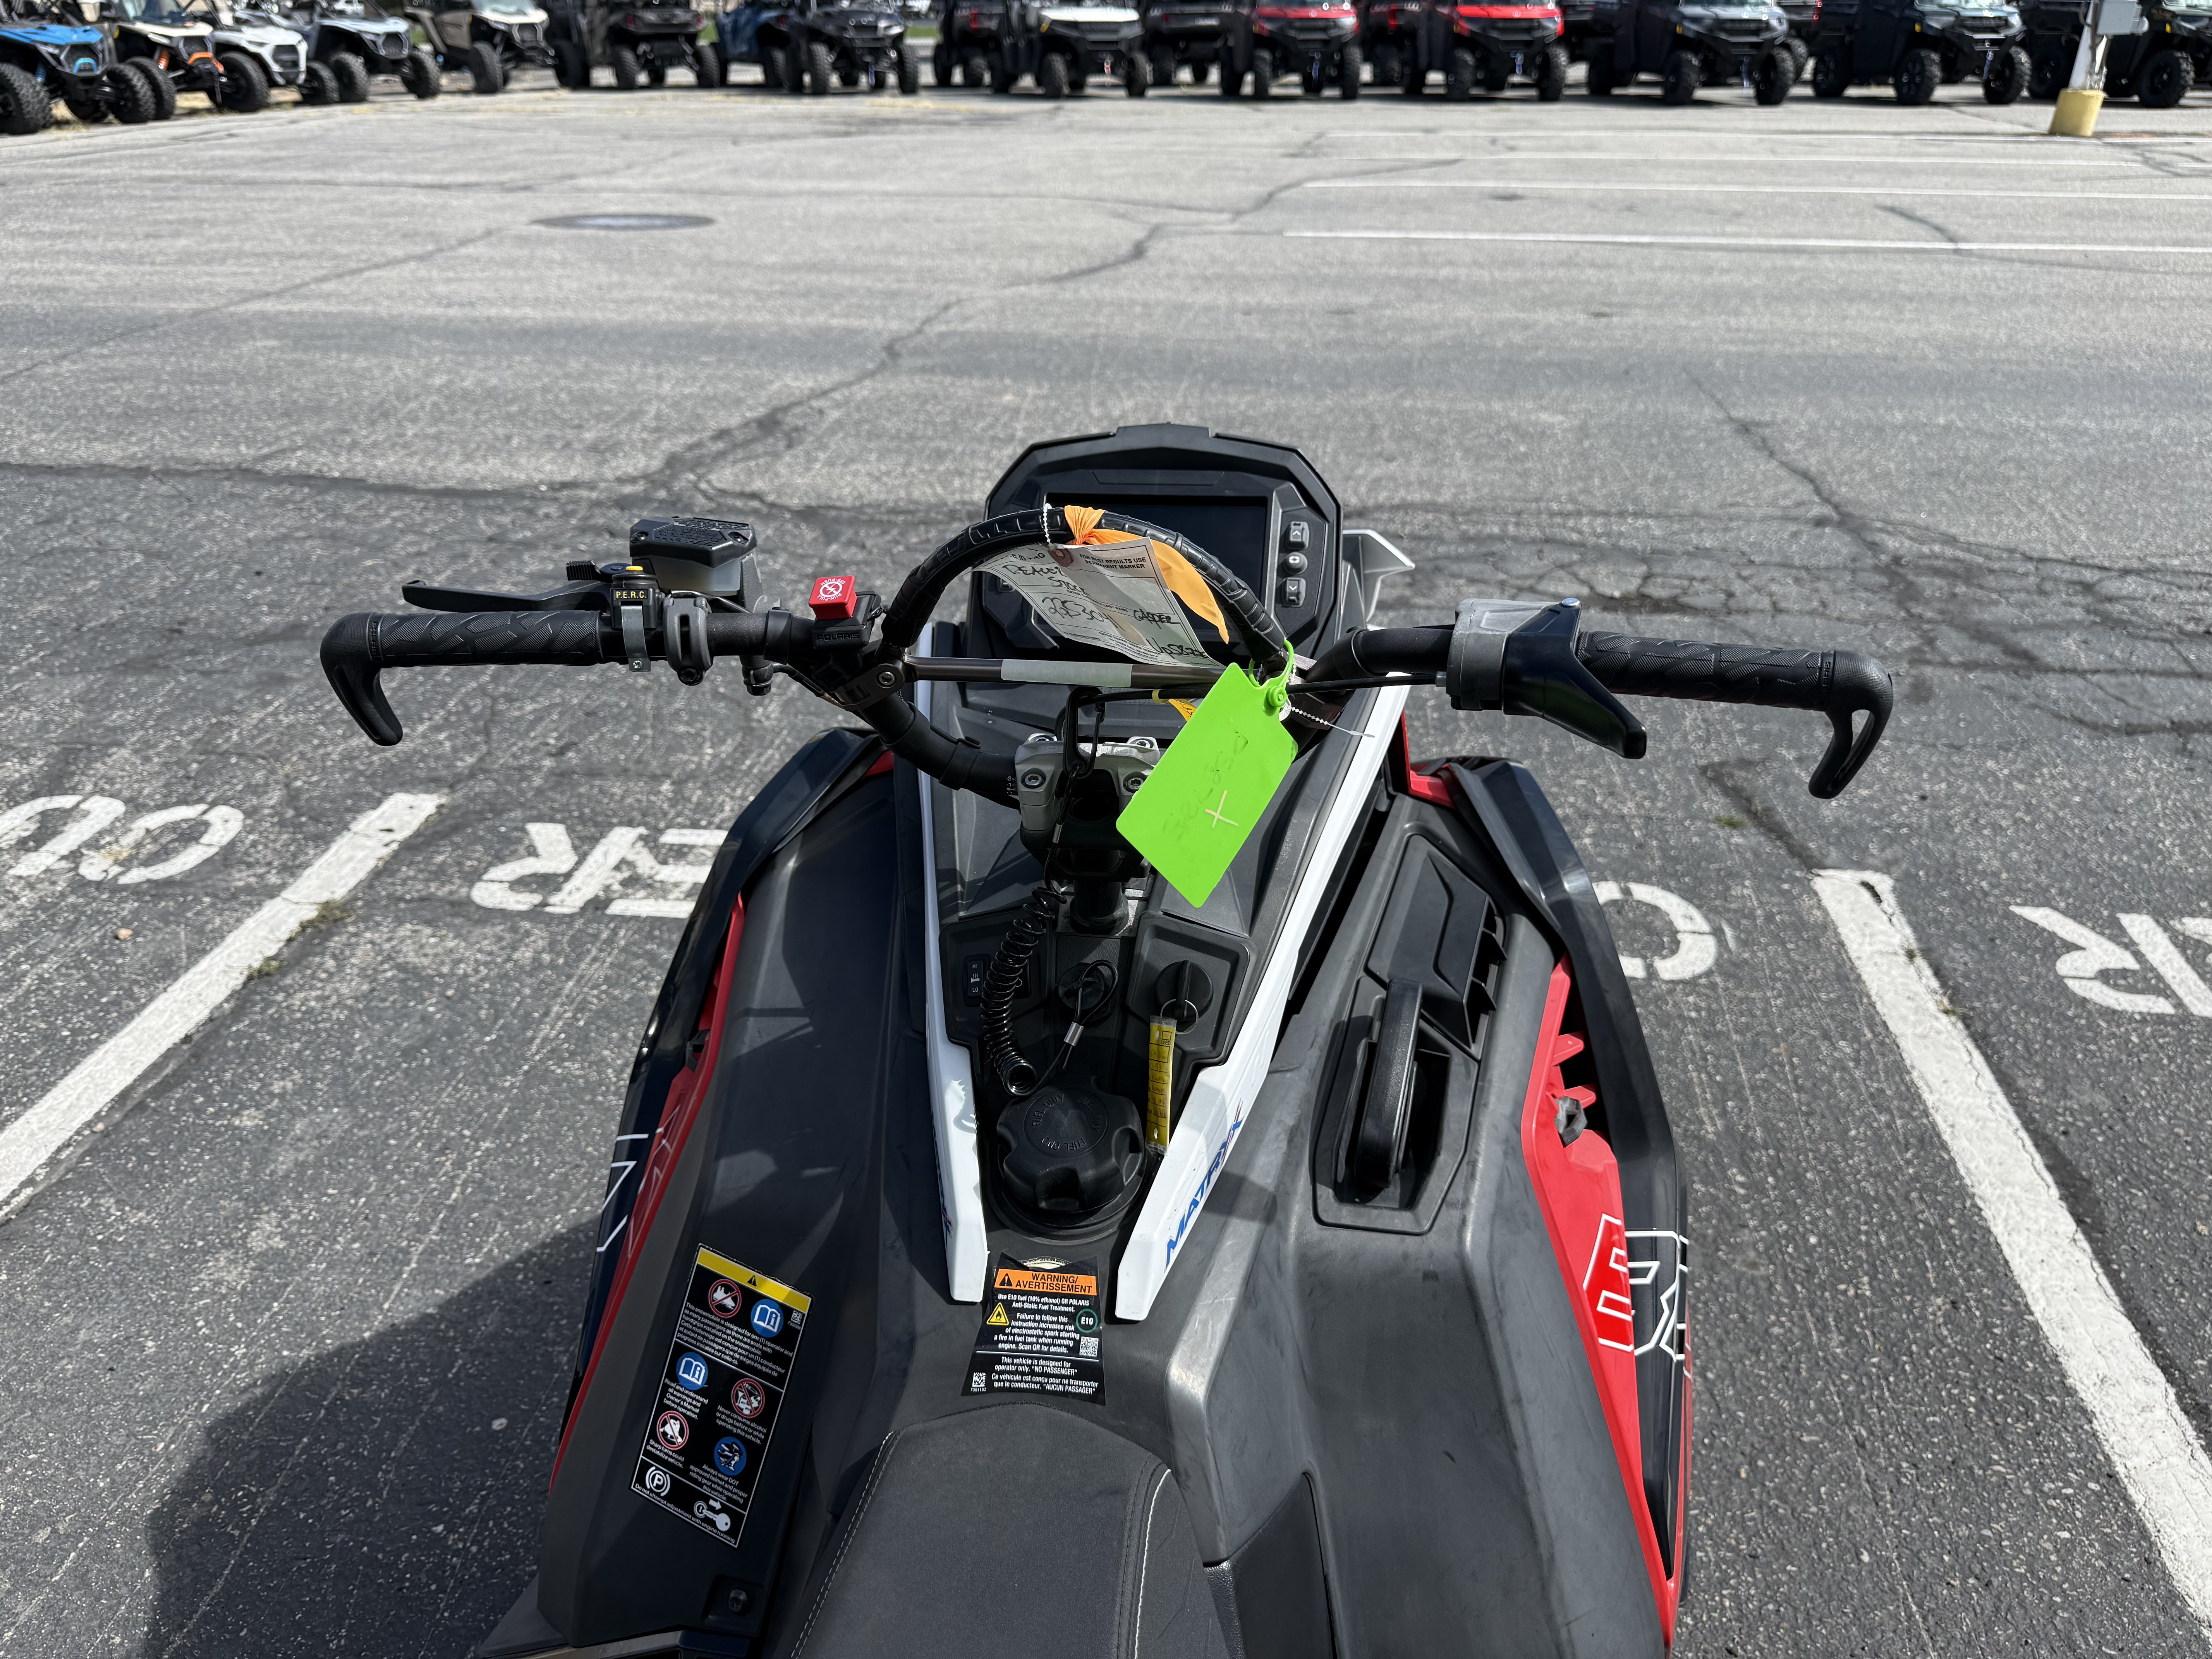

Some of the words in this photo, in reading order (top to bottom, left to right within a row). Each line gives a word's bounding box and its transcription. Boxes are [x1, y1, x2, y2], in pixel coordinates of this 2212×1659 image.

[1085, 560, 1118, 569] PERMANENT
[817, 632, 859, 642] POLARIS
[1032, 1110, 1046, 1127] FUEL
[1043, 1094, 1065, 1108] ONLY
[1031, 1273, 1078, 1284] WARNING/
[1015, 1279, 1092, 1293] AVERTISSEMENT
[1012, 1301, 1037, 1309] Anti-Static
[1049, 1304, 1075, 1312] Treatment.
[1041, 1297, 1060, 1305] ethanol)
[686, 1302, 695, 1310] This
[694, 1307, 720, 1322] snowmobile
[724, 1321, 745, 1334] designed
[765, 1340, 784, 1352] operator
[1011, 1319, 1038, 1328] instruction
[1039, 1321, 1064, 1329] increases
[1081, 1316, 1093, 1325] E10
[689, 1311, 702, 1321] many
[700, 1317, 726, 1332] passengers
[731, 1331, 743, 1340] there
[750, 1340, 762, 1349] seats
[1005, 1326, 1011, 1336] of
[1011, 1327, 1043, 1337] electrostatic
[1043, 1330, 1059, 1338] spark
[1060, 1331, 1080, 1340] starting
[1008, 1334, 1013, 1343] in
[1014, 1335, 1025, 1344] fuel
[1025, 1336, 1037, 1345] tank
[1037, 1337, 1053, 1346] when
[1053, 1338, 1073, 1347] running
[1049, 1345, 1068, 1353] details.
[1013, 1357, 1032, 1365] vehicle
[1032, 1358, 1038, 1366] is
[1039, 1358, 1062, 1367] designed
[1043, 1366, 1077, 1376] PASSENGER"
[1022, 1375, 1032, 1383] est
[1070, 1378, 1098, 1388] transporter
[664, 1378, 677, 1388] Read
[684, 1389, 708, 1404] understand
[1043, 1383, 1064, 1391] "AUCUN
[1065, 1385, 1095, 1395] PASSAGER"
[673, 1390, 692, 1403] warnings
[663, 1398, 677, 1408] before
[677, 1405, 698, 1419] operation.
[683, 1401, 699, 1413] Manual
[717, 1405, 731, 1415] Never
[730, 1412, 750, 1425] consume
[750, 1422, 767, 1433] alcohol
[716, 1419, 737, 1433] operating
[745, 1433, 761, 1444] vehicle.
[720, 1414, 733, 1424] drugs
[733, 1419, 748, 1431] before
[752, 1430, 764, 1439] while
[646, 1445, 668, 1460] destabilize
[668, 1456, 683, 1468] vehicle.
[649, 1439, 662, 1449] Sharp
[661, 1444, 672, 1455] turns
[672, 1452, 684, 1462] could
[689, 1465, 710, 1478] approved
[709, 1474, 725, 1486] helmet
[732, 1487, 747, 1498] proper
[702, 1464, 718, 1475] Always
[718, 1472, 729, 1481] wear
[728, 1477, 739, 1486] DOT
[689, 1471, 702, 1482] riding
[711, 1483, 723, 1492] while
[722, 1489, 743, 1504] operating
[711, 1489, 726, 1501] vehicle.
[649, 1492, 666, 1505] attempt
[666, 1502, 692, 1519] adjustment
[701, 1522, 717, 1533] engine
[717, 1528, 735, 1544] running
